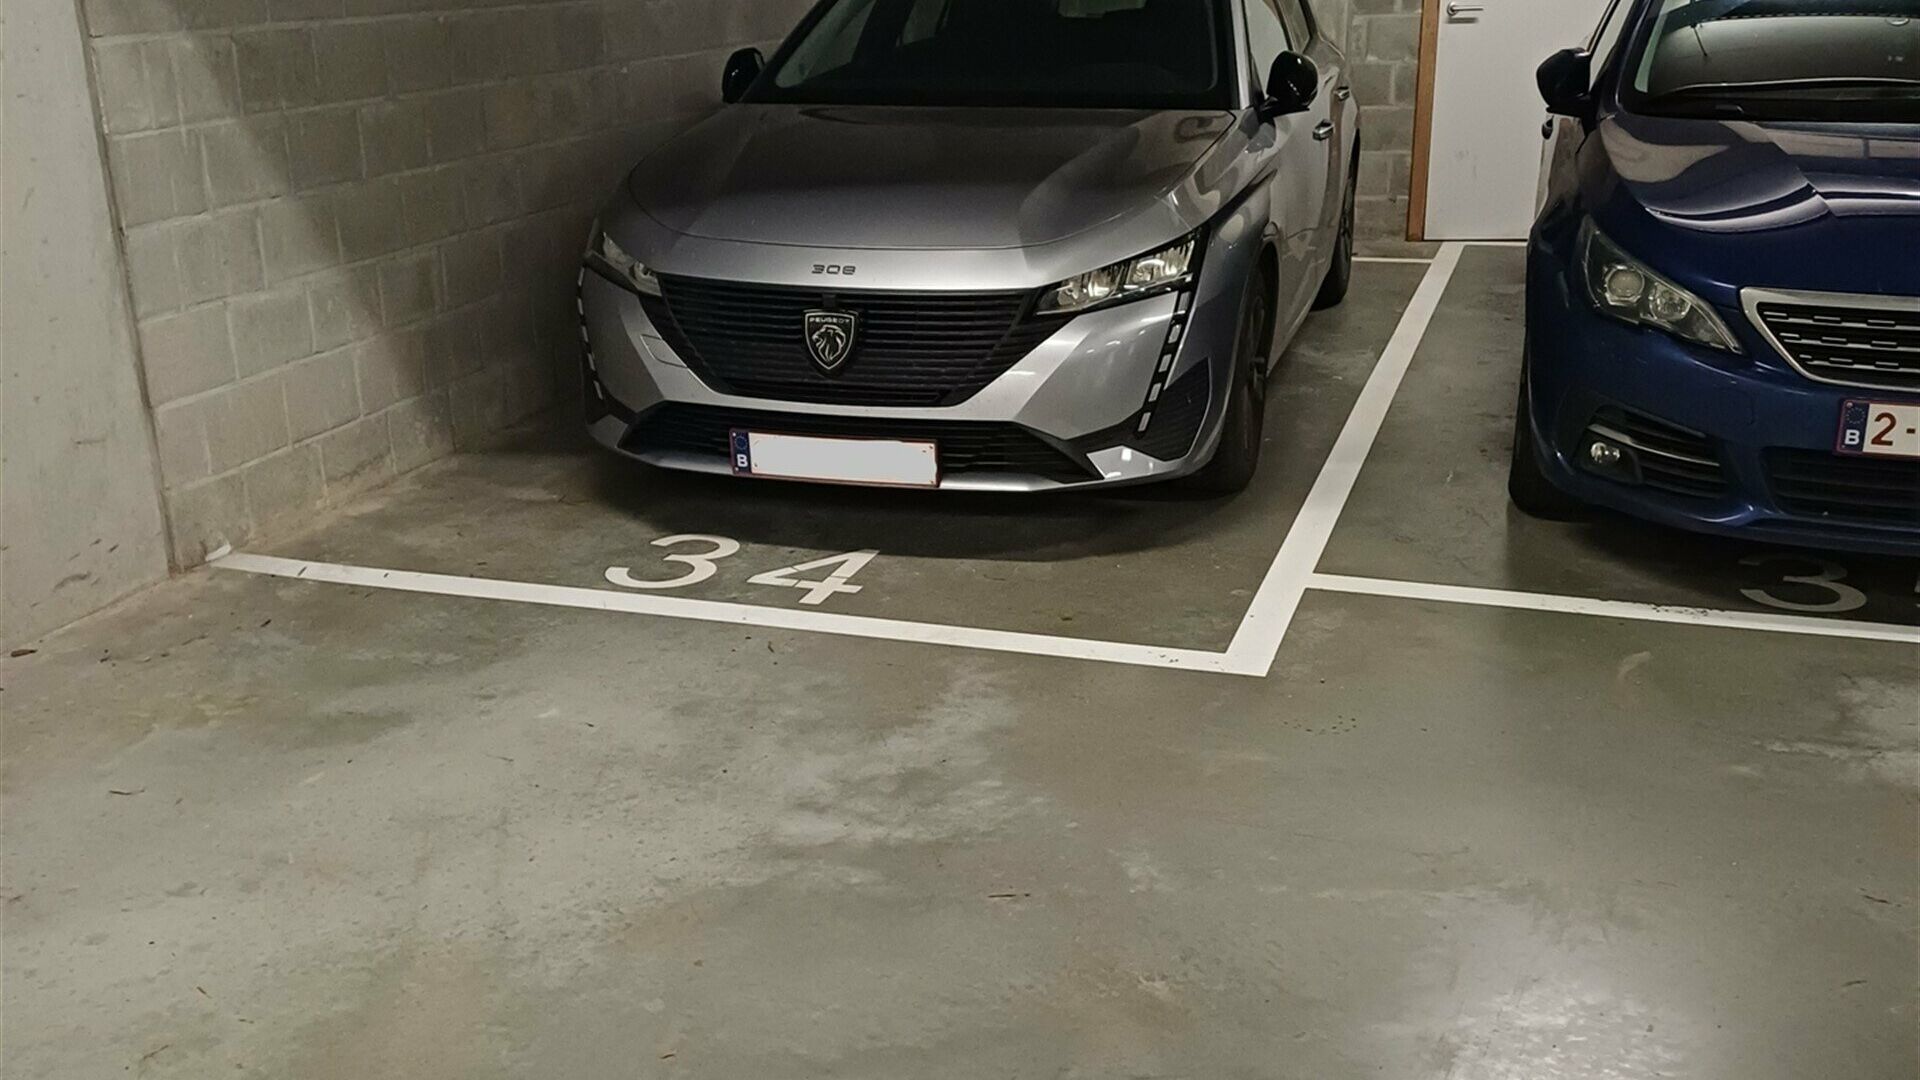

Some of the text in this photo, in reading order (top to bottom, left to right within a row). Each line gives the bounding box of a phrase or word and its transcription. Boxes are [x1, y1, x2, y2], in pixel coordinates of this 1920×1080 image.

[811, 264, 856, 275] 308
[1844, 429, 1860, 445] B
[737, 454, 748, 467] B
[604, 533, 879, 605] 34
